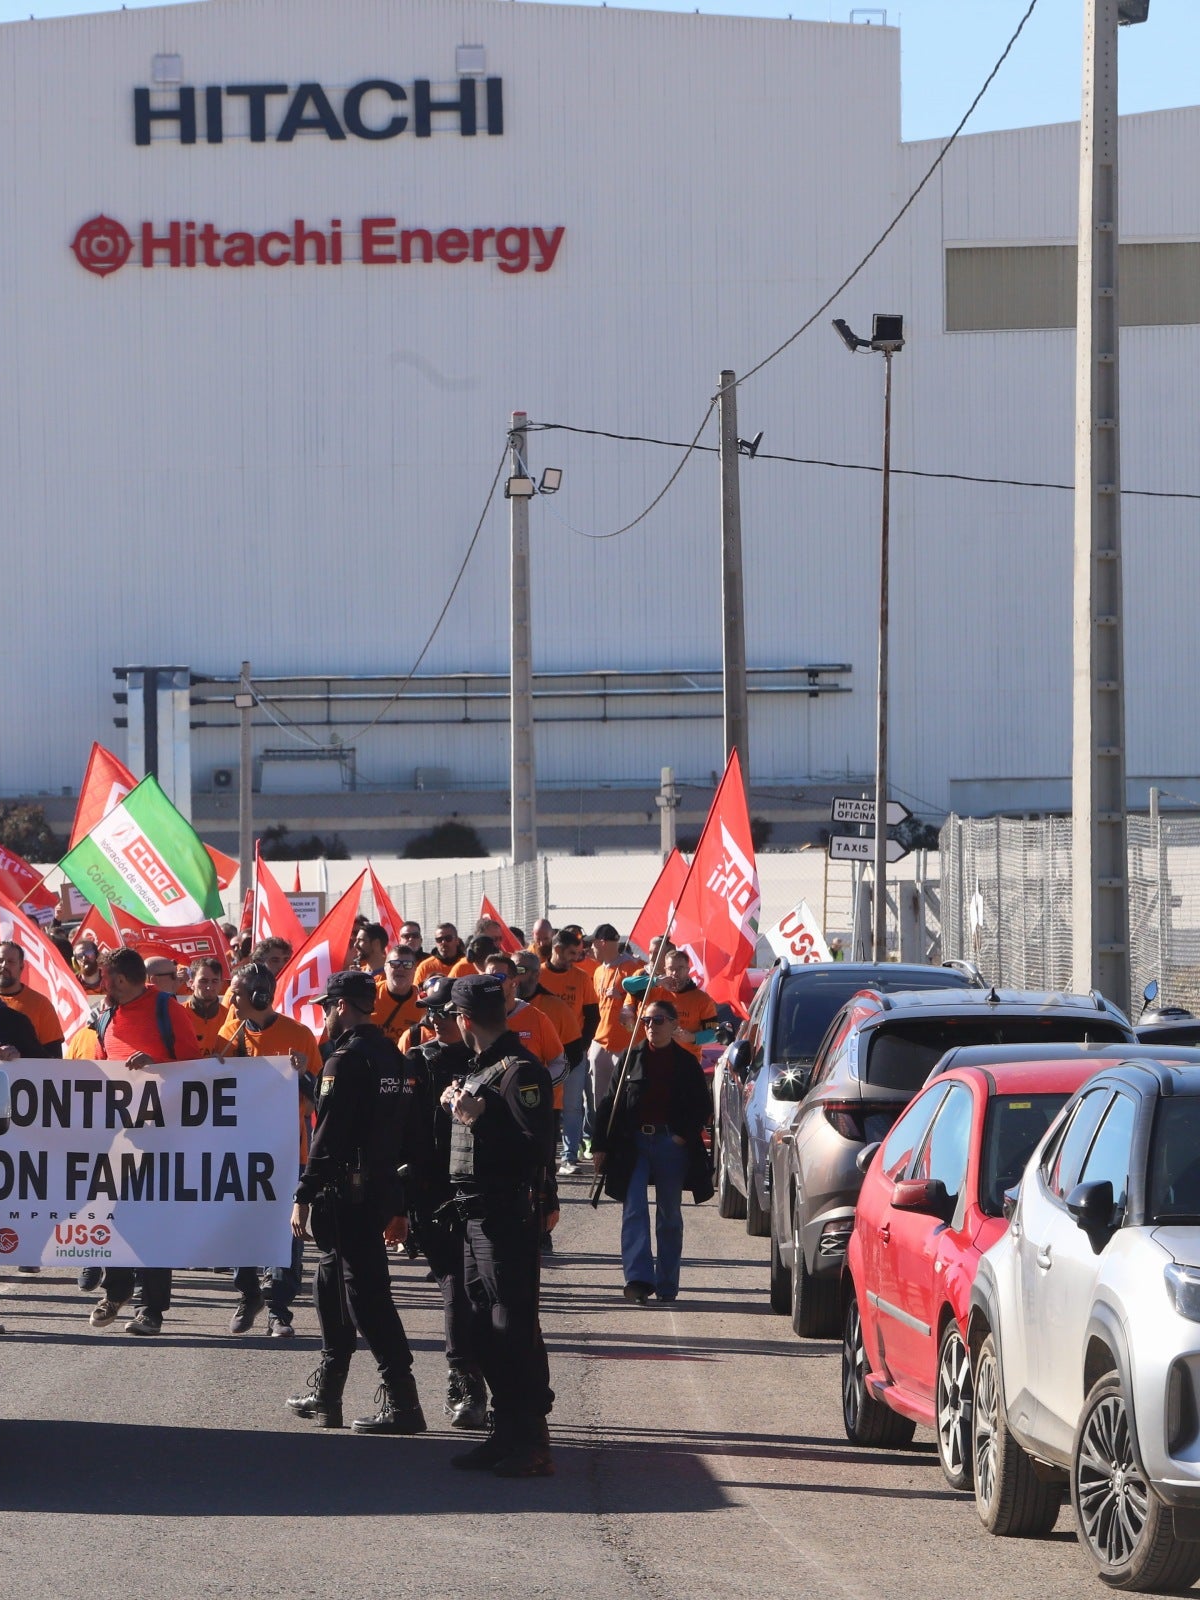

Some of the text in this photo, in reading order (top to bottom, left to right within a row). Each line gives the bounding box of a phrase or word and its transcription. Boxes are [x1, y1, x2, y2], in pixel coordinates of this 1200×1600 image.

[134, 77, 503, 146] HITACHI
[141, 217, 565, 274] Hitachi Energy
[838, 802, 875, 811] HITACH
[128, 841, 171, 891] CCOO
[836, 843, 868, 853] TAXIS
[10, 1077, 238, 1129] ONTRA DE
[66, 1151, 277, 1202] FAMILIAR
[55, 1224, 111, 1245] USO
[56, 1246, 112, 1258] industria
